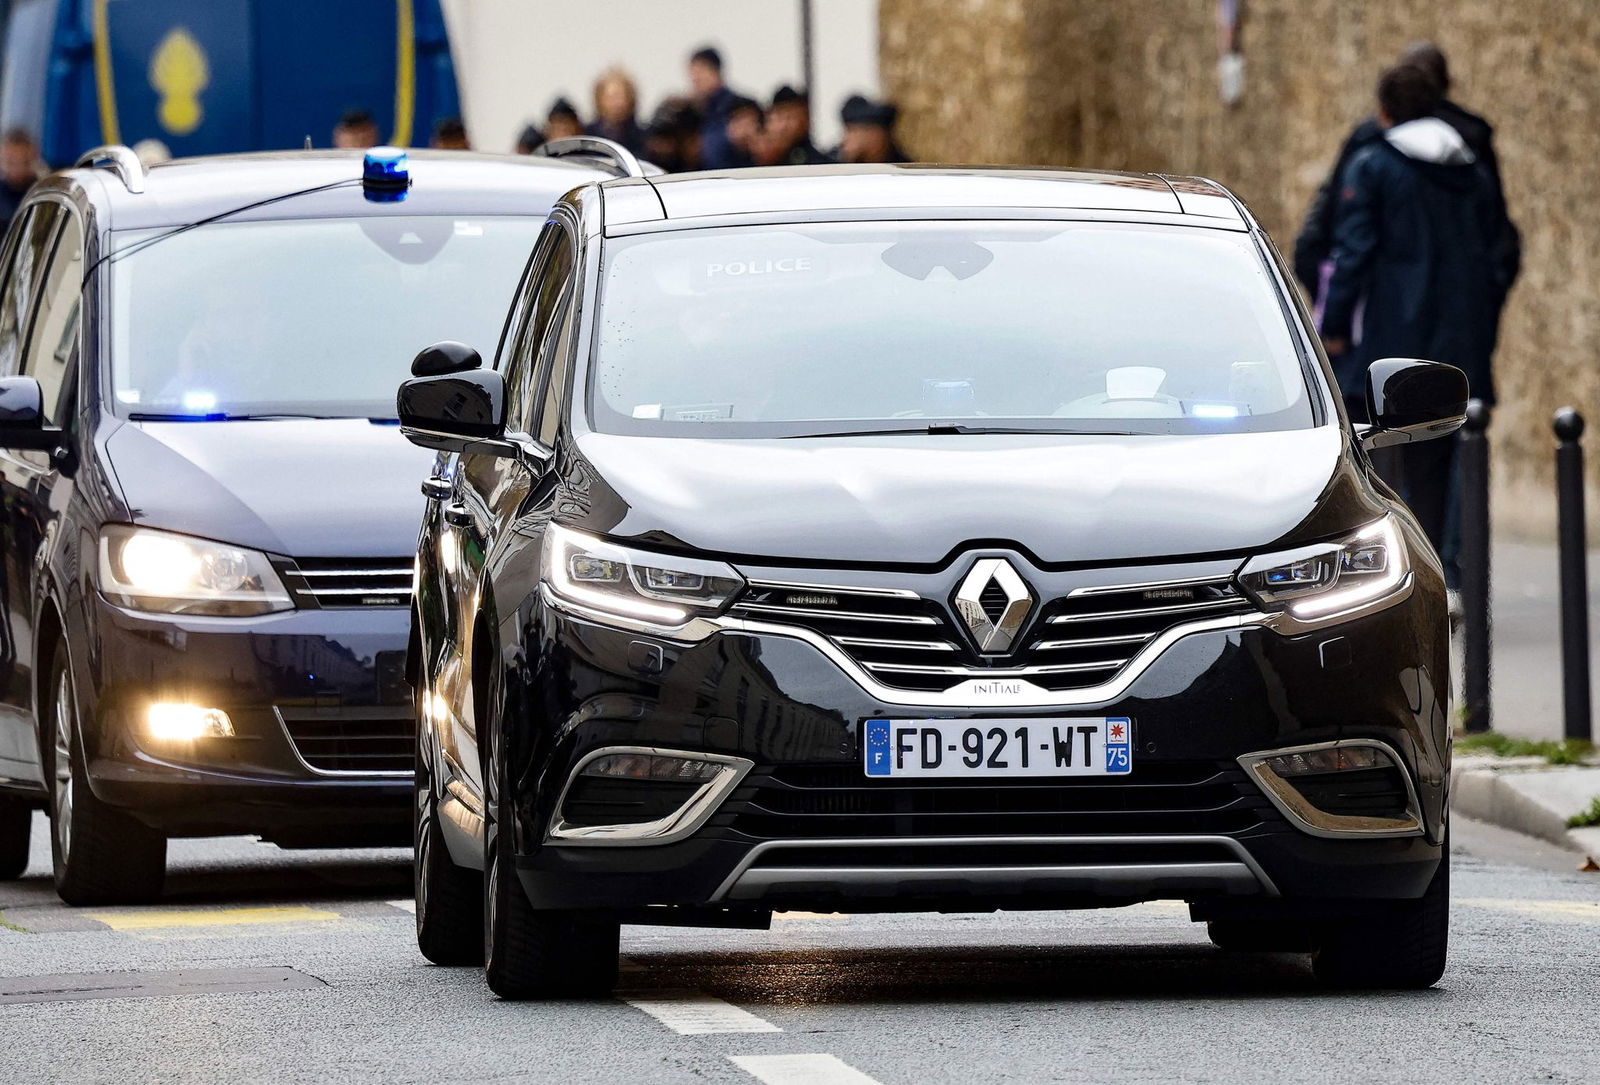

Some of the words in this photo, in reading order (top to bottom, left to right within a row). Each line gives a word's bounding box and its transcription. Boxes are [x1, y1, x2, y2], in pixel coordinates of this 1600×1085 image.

[706, 257, 812, 277] POLICE
[974, 682, 1021, 694] INITIALE
[896, 726, 1098, 769] FD-921-WT
[1107, 747, 1128, 767] 75
[875, 752, 883, 764] F
